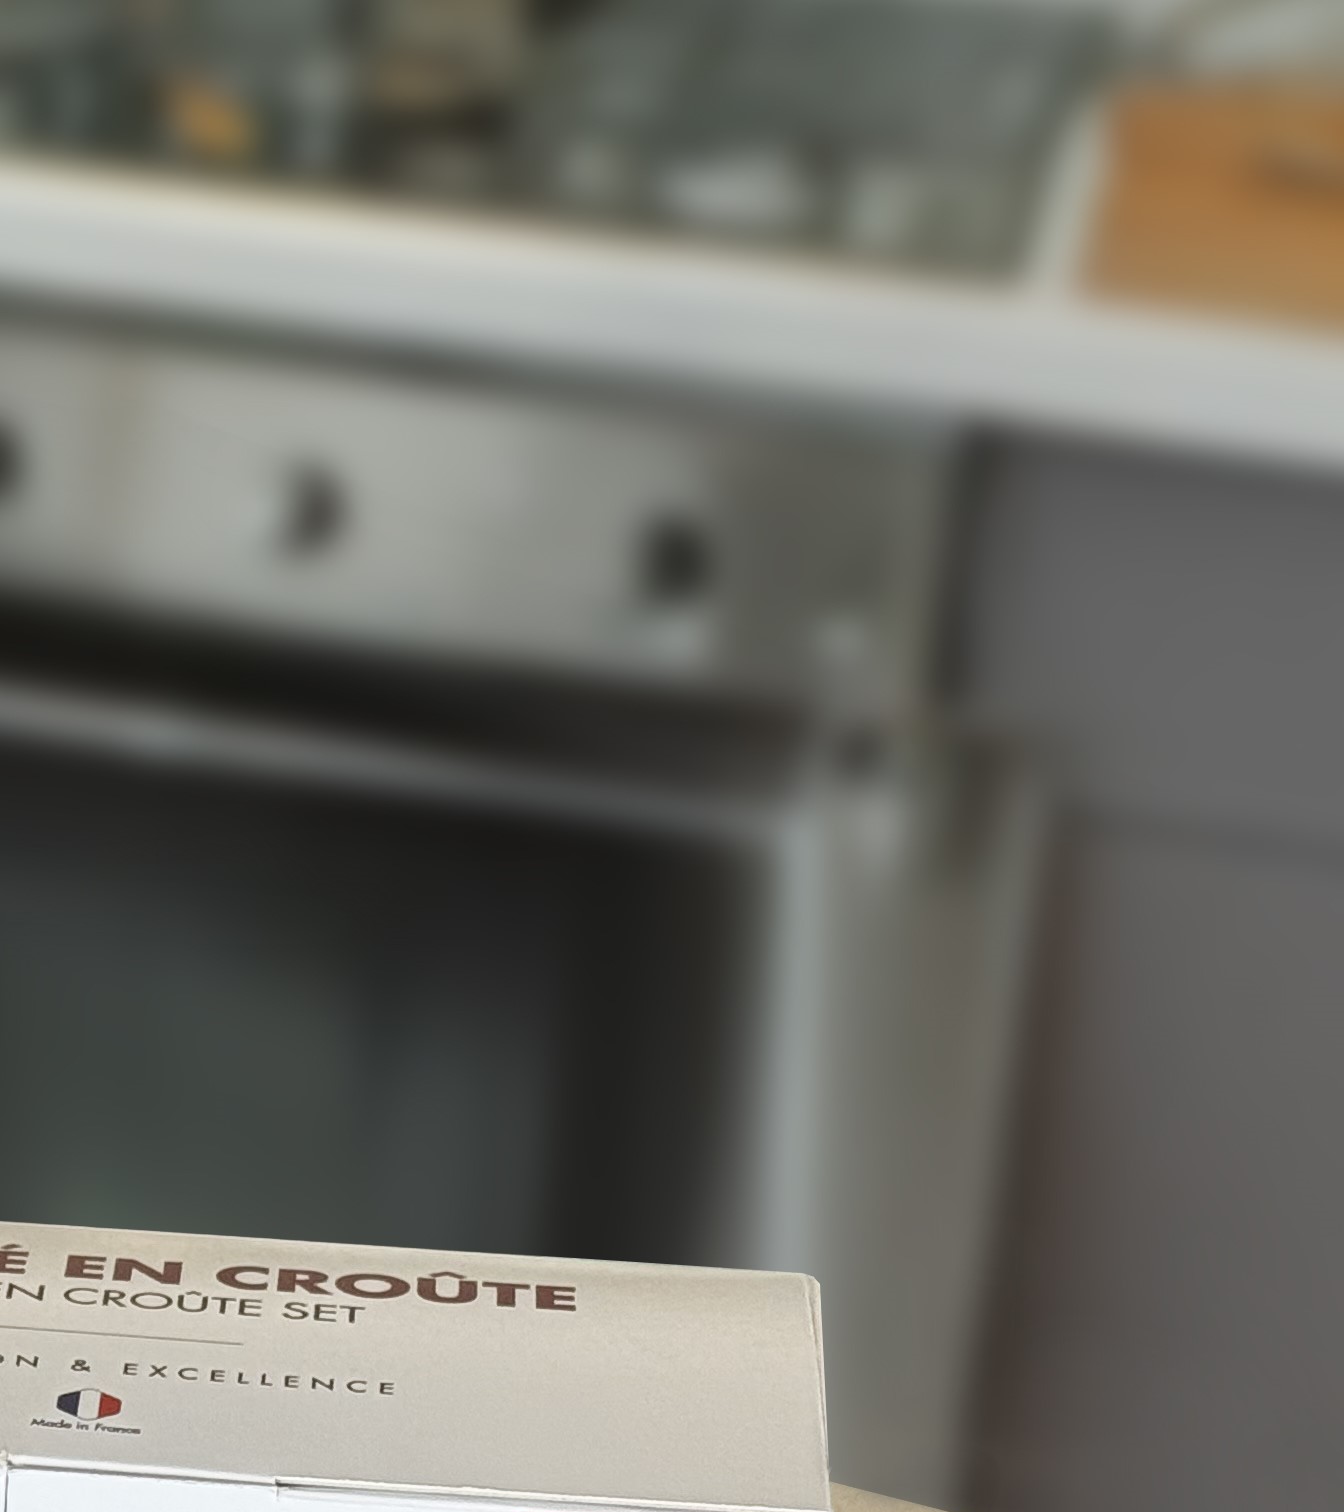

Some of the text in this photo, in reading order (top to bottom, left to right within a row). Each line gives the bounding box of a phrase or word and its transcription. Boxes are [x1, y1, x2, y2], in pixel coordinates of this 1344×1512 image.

[64, 1254, 183, 1285] EN
[216, 1265, 577, 1312] CROÛTE
[64, 1287, 262, 1317] CROÛTE
[282, 1301, 366, 1325] SET
[70, 1358, 91, 1373] &
[122, 1362, 396, 1396] EXCELLENCE
[30, 1418, 72, 1430] Made
[76, 1421, 90, 1432] in
